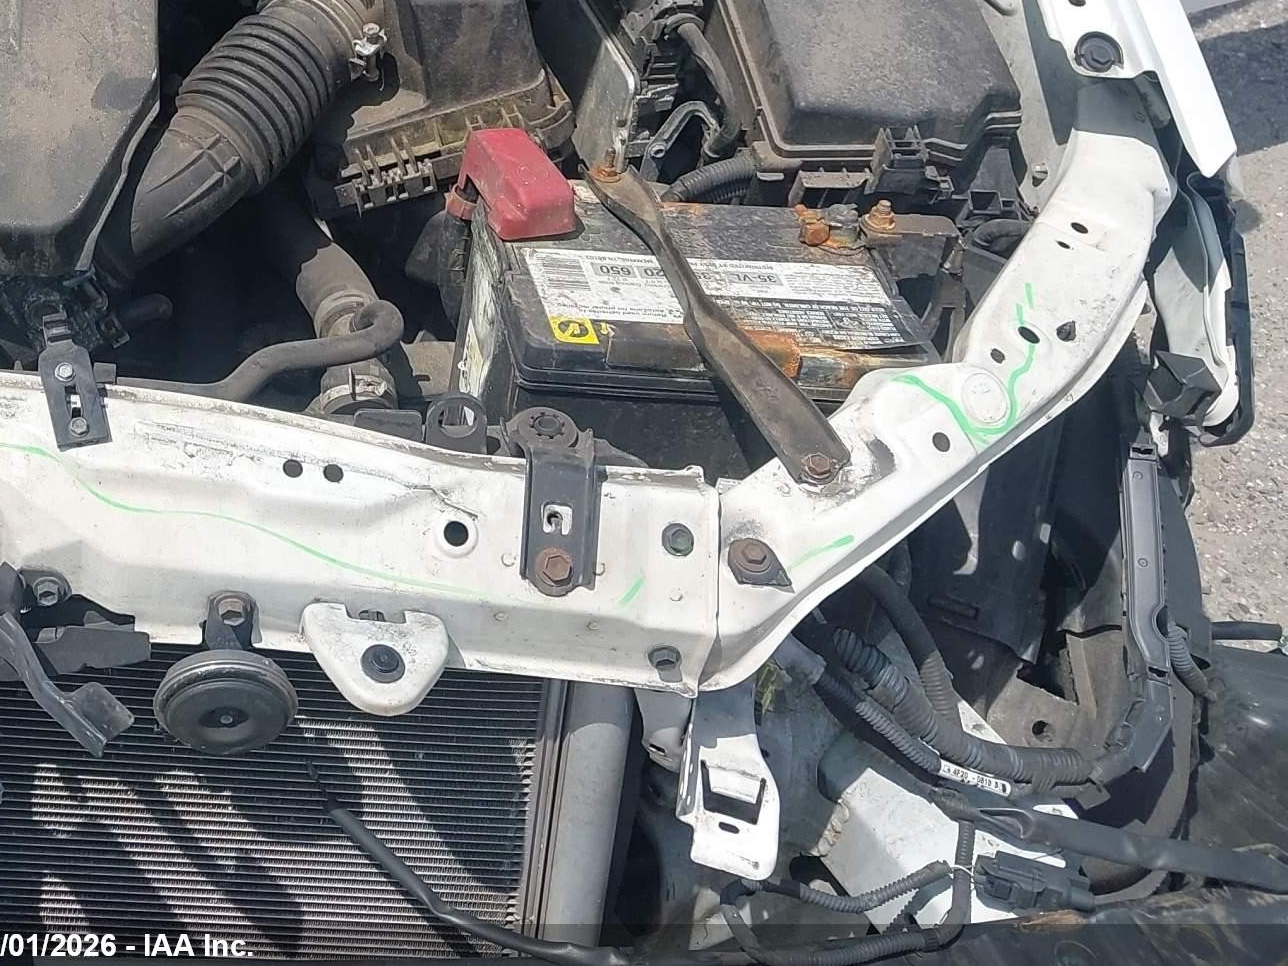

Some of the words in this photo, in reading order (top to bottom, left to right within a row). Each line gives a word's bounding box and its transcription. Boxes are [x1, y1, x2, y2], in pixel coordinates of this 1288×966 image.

[599, 264, 631, 276] 650
[644, 267, 665, 277] 20
[729, 272, 777, 283] 35-VL
